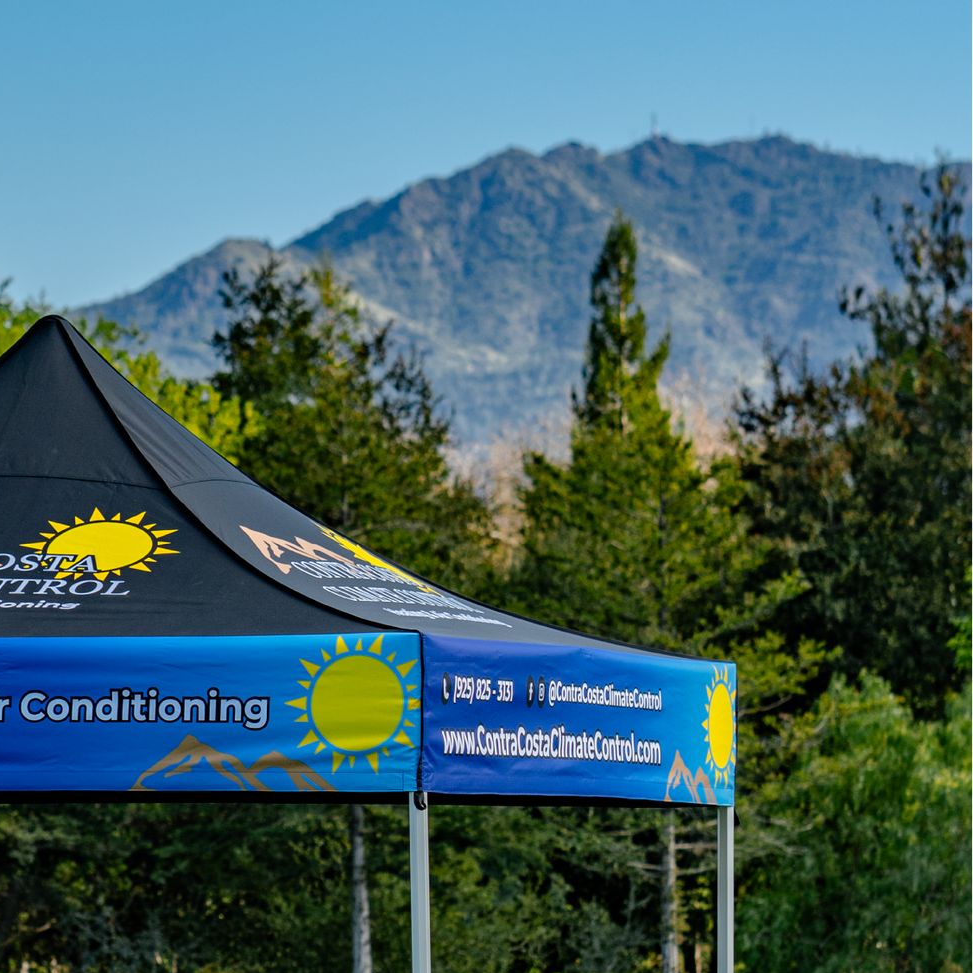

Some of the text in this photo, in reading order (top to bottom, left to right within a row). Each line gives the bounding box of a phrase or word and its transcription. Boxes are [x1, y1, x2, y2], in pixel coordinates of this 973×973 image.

[20, 687, 271, 730] Conditioning
[453, 675, 475, 705] (925)
[475, 677, 492, 701] 825
[496, 679, 514, 703] 3131
[548, 679, 663, 712] @ContraCostaClimateControl
[441, 722, 662, 765] www.ContraCostaClimateControl.com
